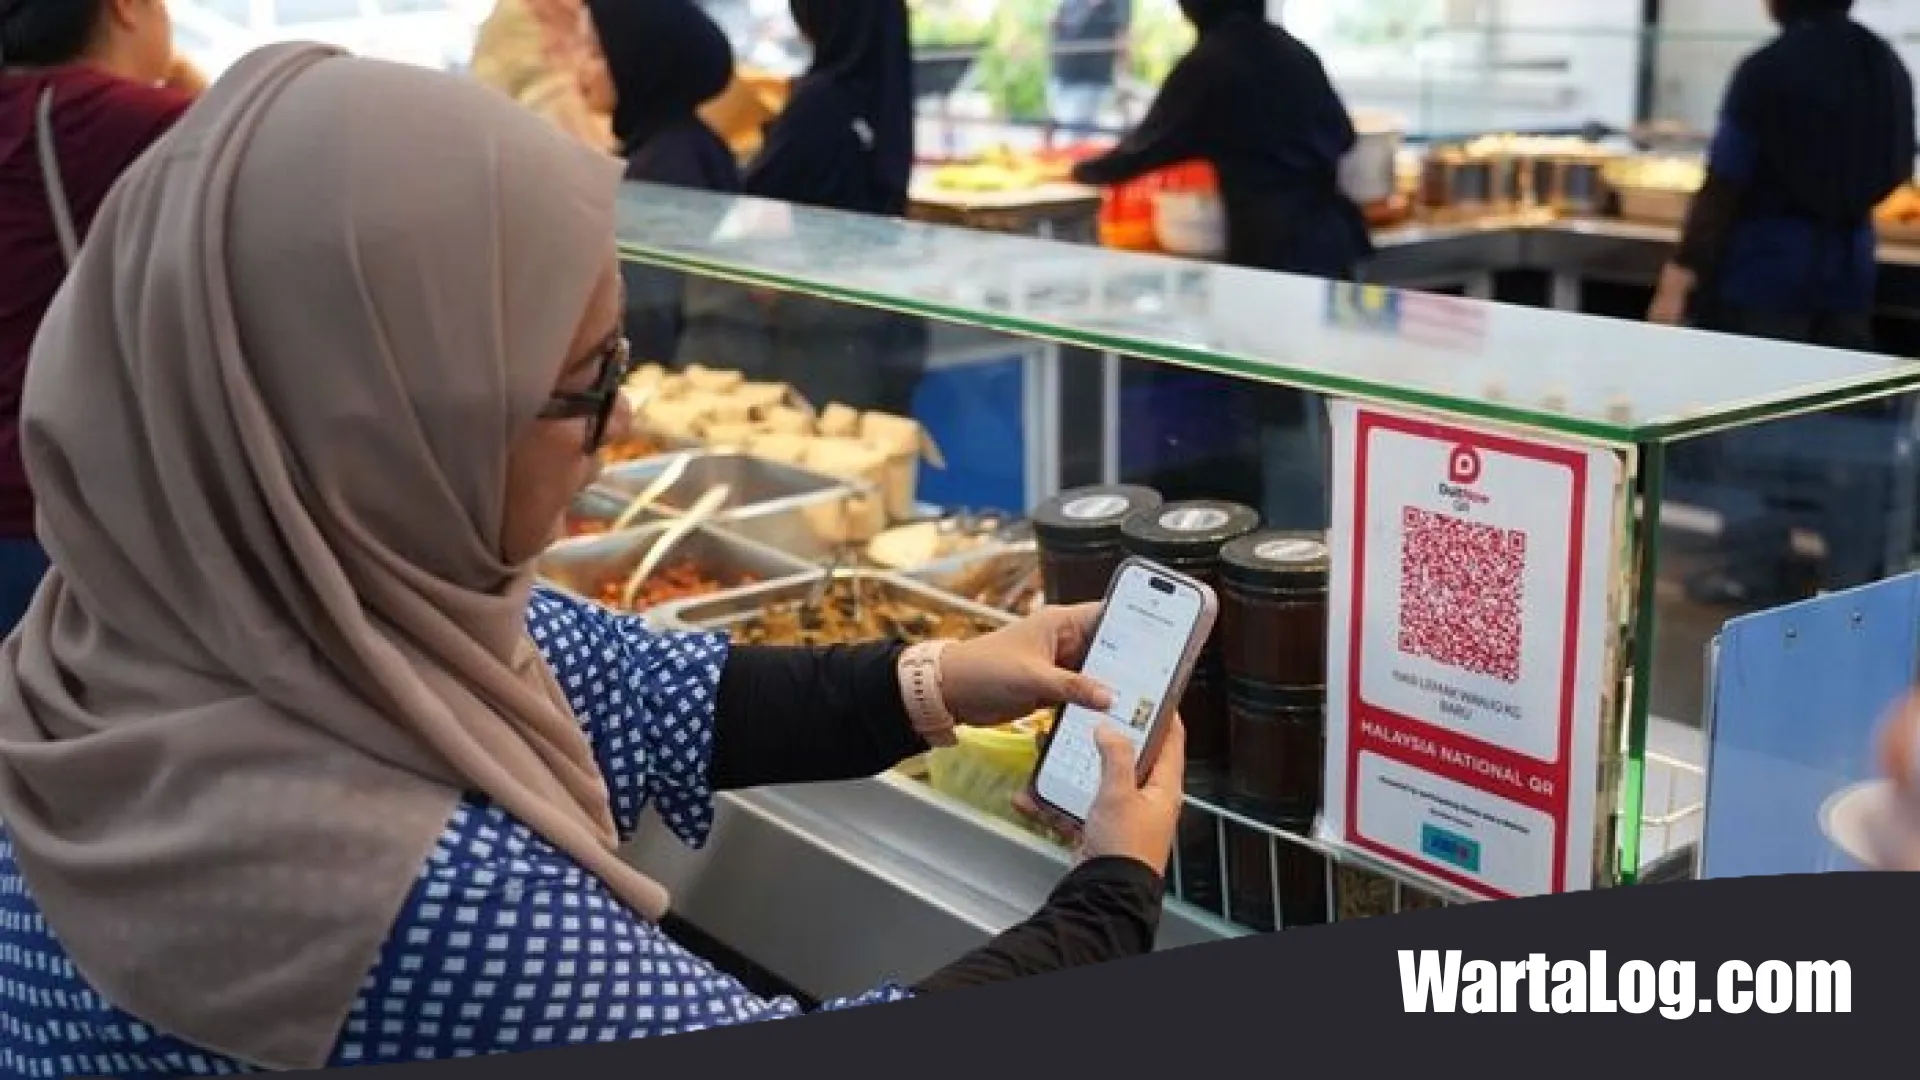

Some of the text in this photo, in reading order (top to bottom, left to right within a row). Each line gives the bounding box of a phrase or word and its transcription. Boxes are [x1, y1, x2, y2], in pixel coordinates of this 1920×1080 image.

[1361, 719, 1553, 796] MALAYSIA NATIONAL QR
